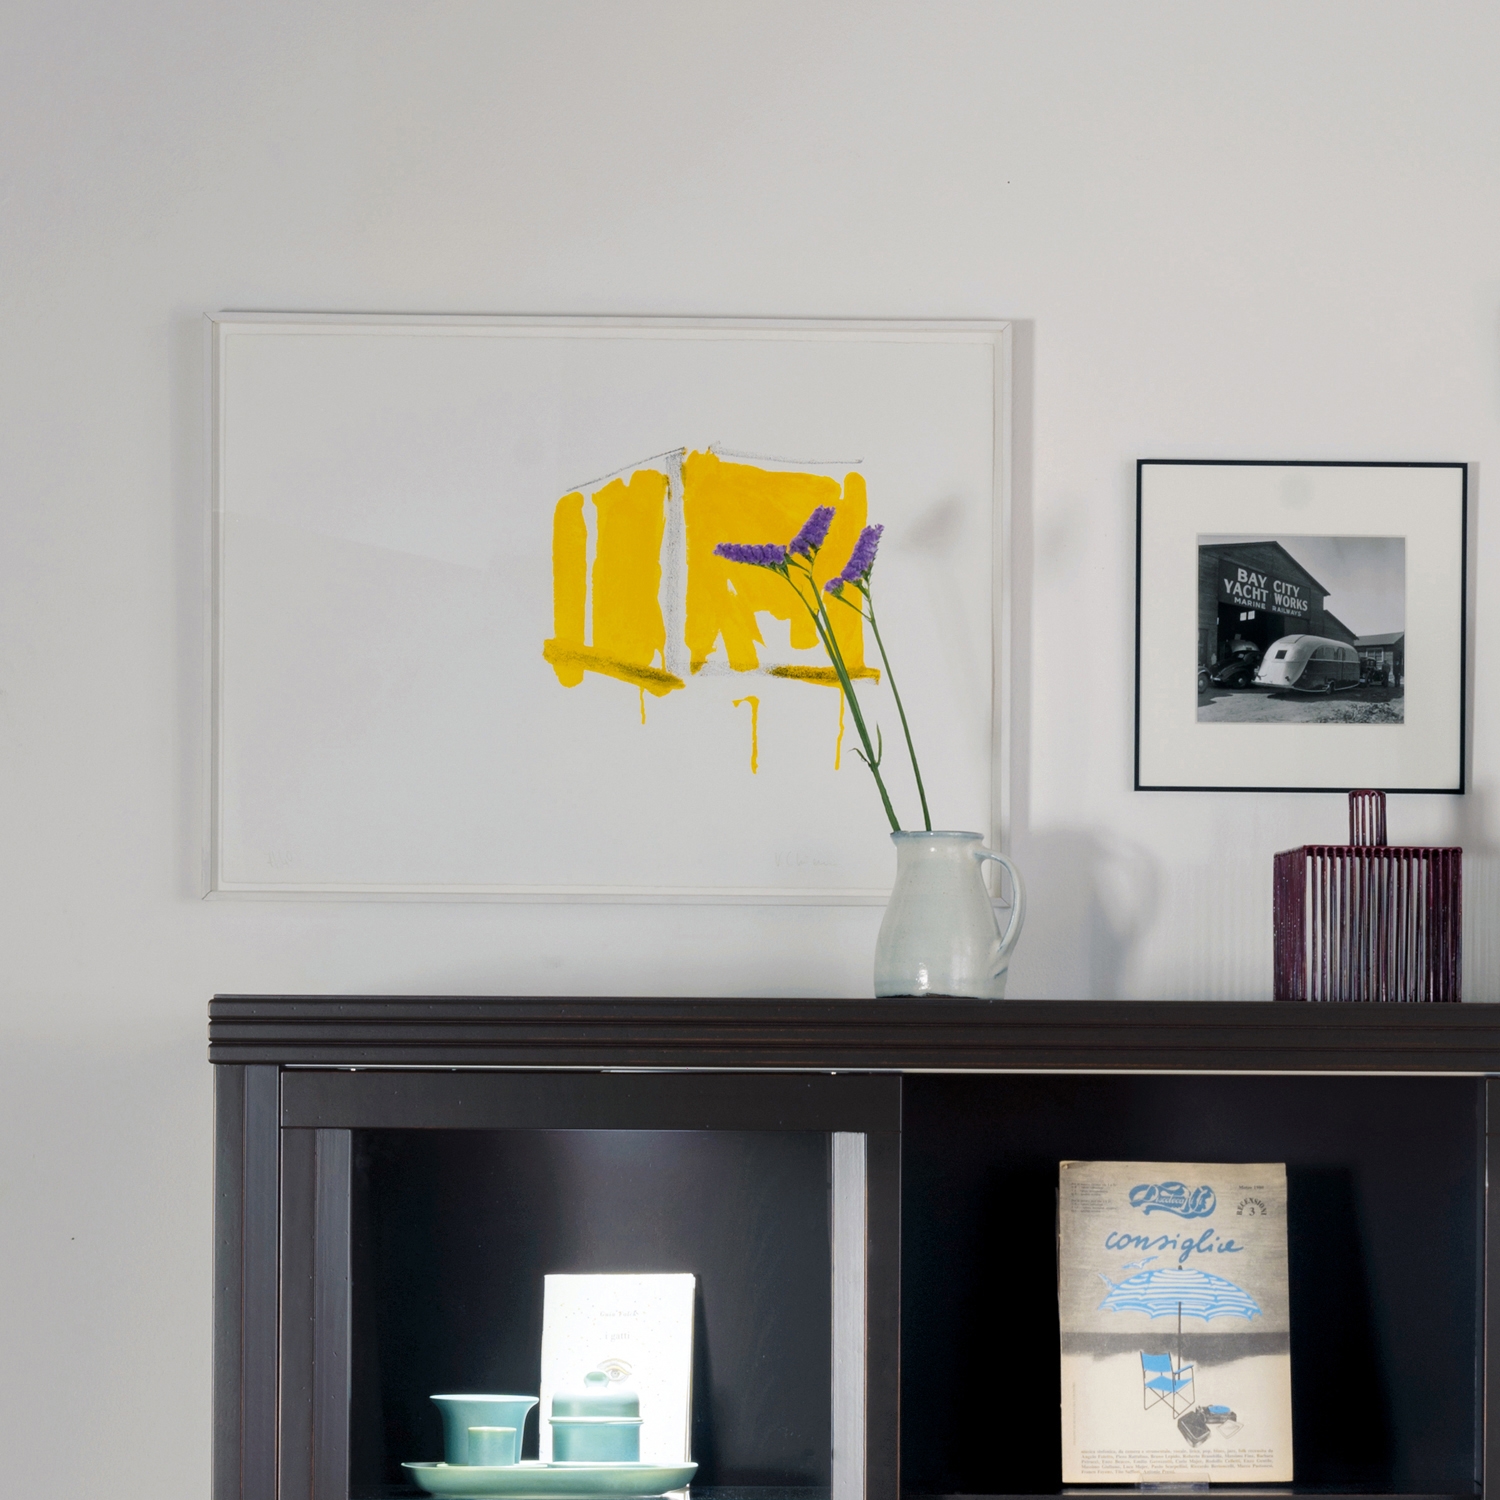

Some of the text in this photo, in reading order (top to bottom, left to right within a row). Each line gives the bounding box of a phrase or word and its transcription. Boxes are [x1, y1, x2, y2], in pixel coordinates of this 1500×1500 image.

[1237, 567, 1300, 598] BAY CITY
[1223, 578, 1308, 612] YACHT WORKS
[1234, 597, 1302, 617] MARINE RAILWAYS
[1236, 1197, 1268, 1216] RECENSIONI
[1248, 1206, 1256, 1217] 3
